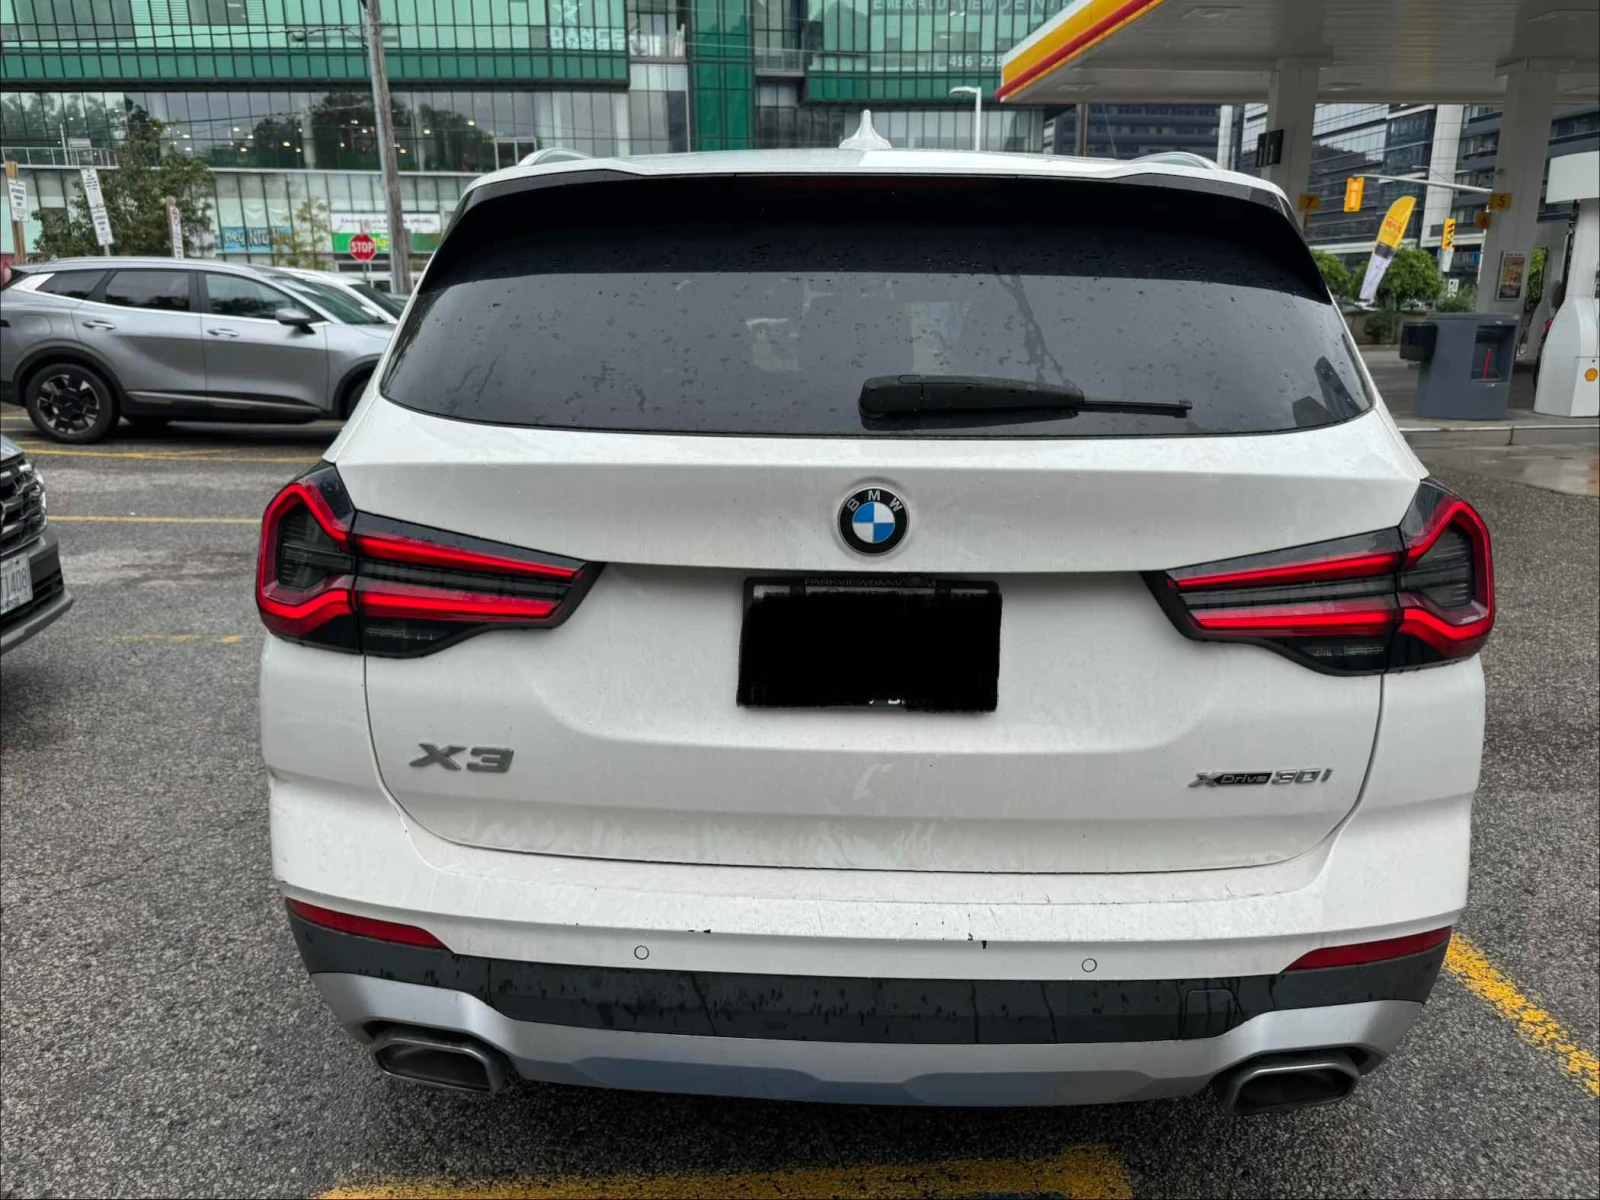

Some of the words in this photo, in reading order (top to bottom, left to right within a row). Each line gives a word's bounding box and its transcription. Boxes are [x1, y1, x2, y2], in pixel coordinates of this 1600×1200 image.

[949, 55, 973, 68] 416
[1304, 196, 1315, 209] 7
[1497, 195, 1507, 208] 5
[351, 241, 374, 254] STOP
[846, 490, 903, 513] BMW
[408, 742, 514, 774] X3
